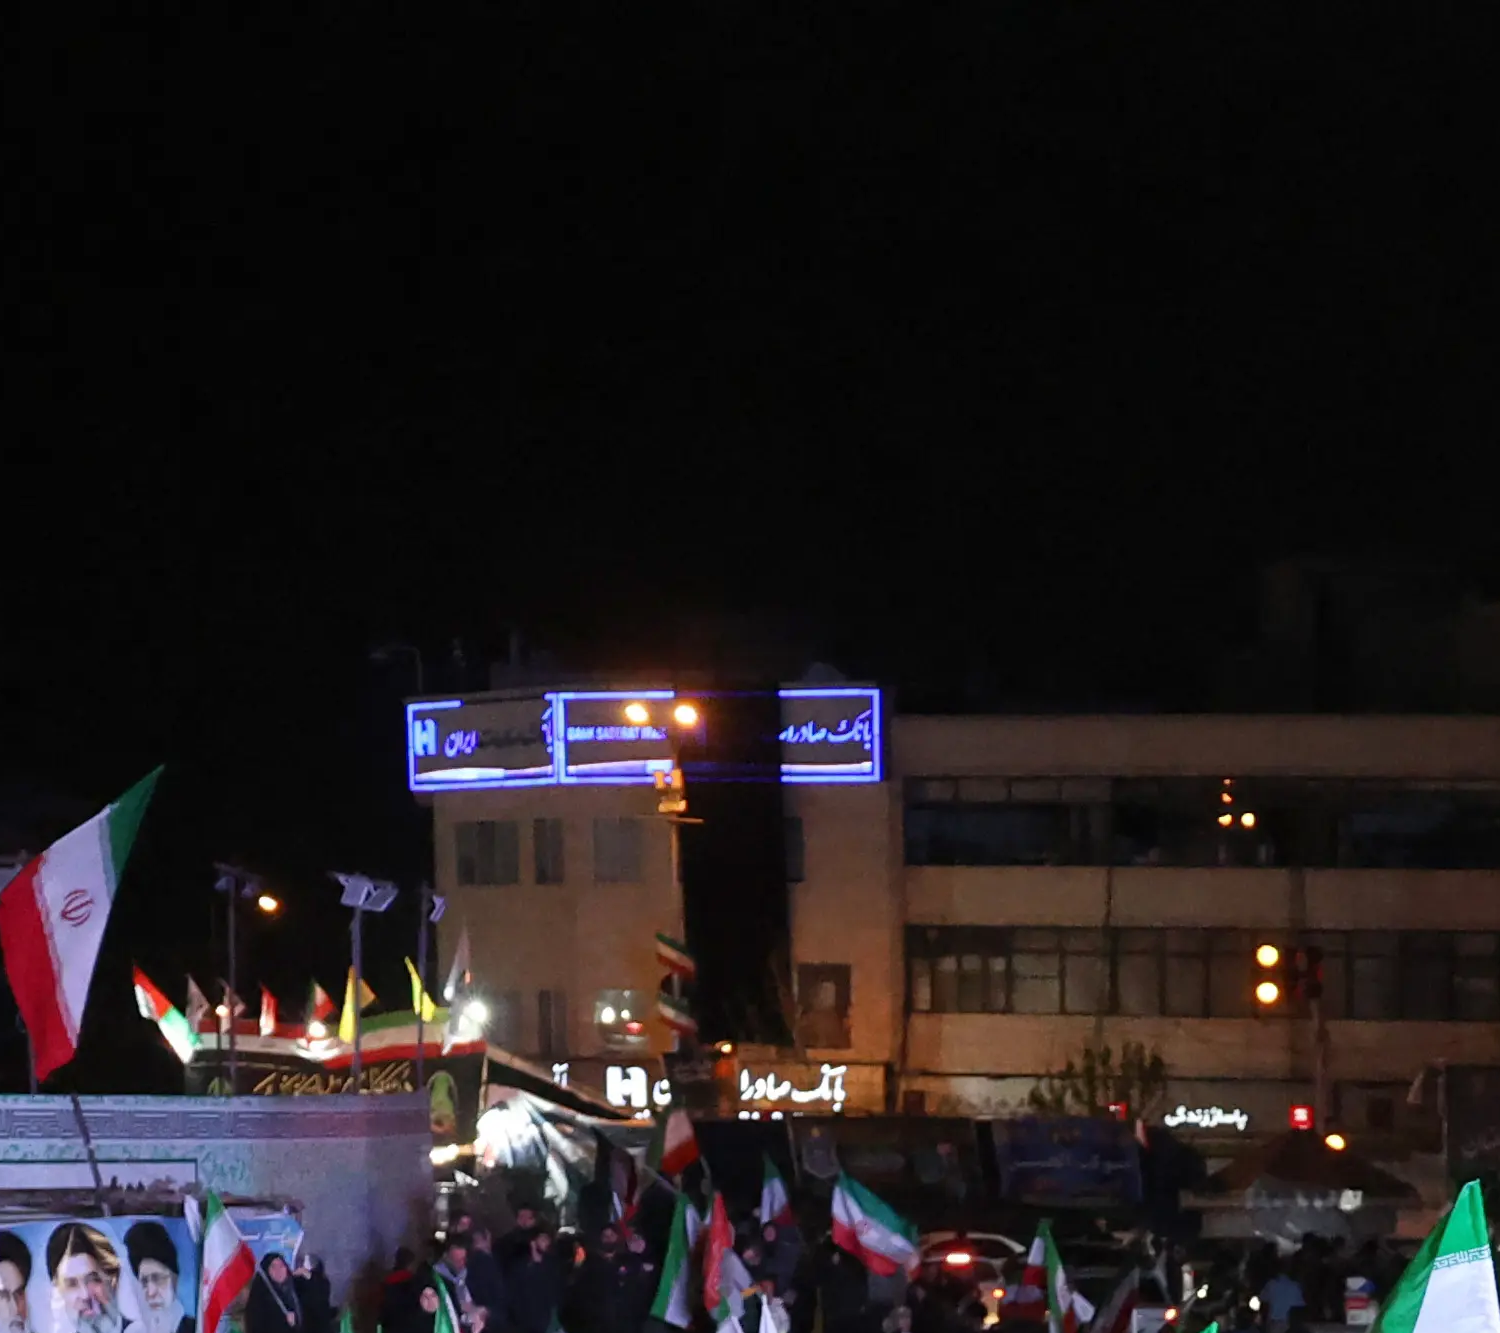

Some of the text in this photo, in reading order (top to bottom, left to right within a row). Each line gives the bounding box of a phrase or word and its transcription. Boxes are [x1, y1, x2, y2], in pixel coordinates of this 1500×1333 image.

[779, 709, 872, 750] بانک صادرا
[739, 1064, 848, 1112] بانک صادرا
